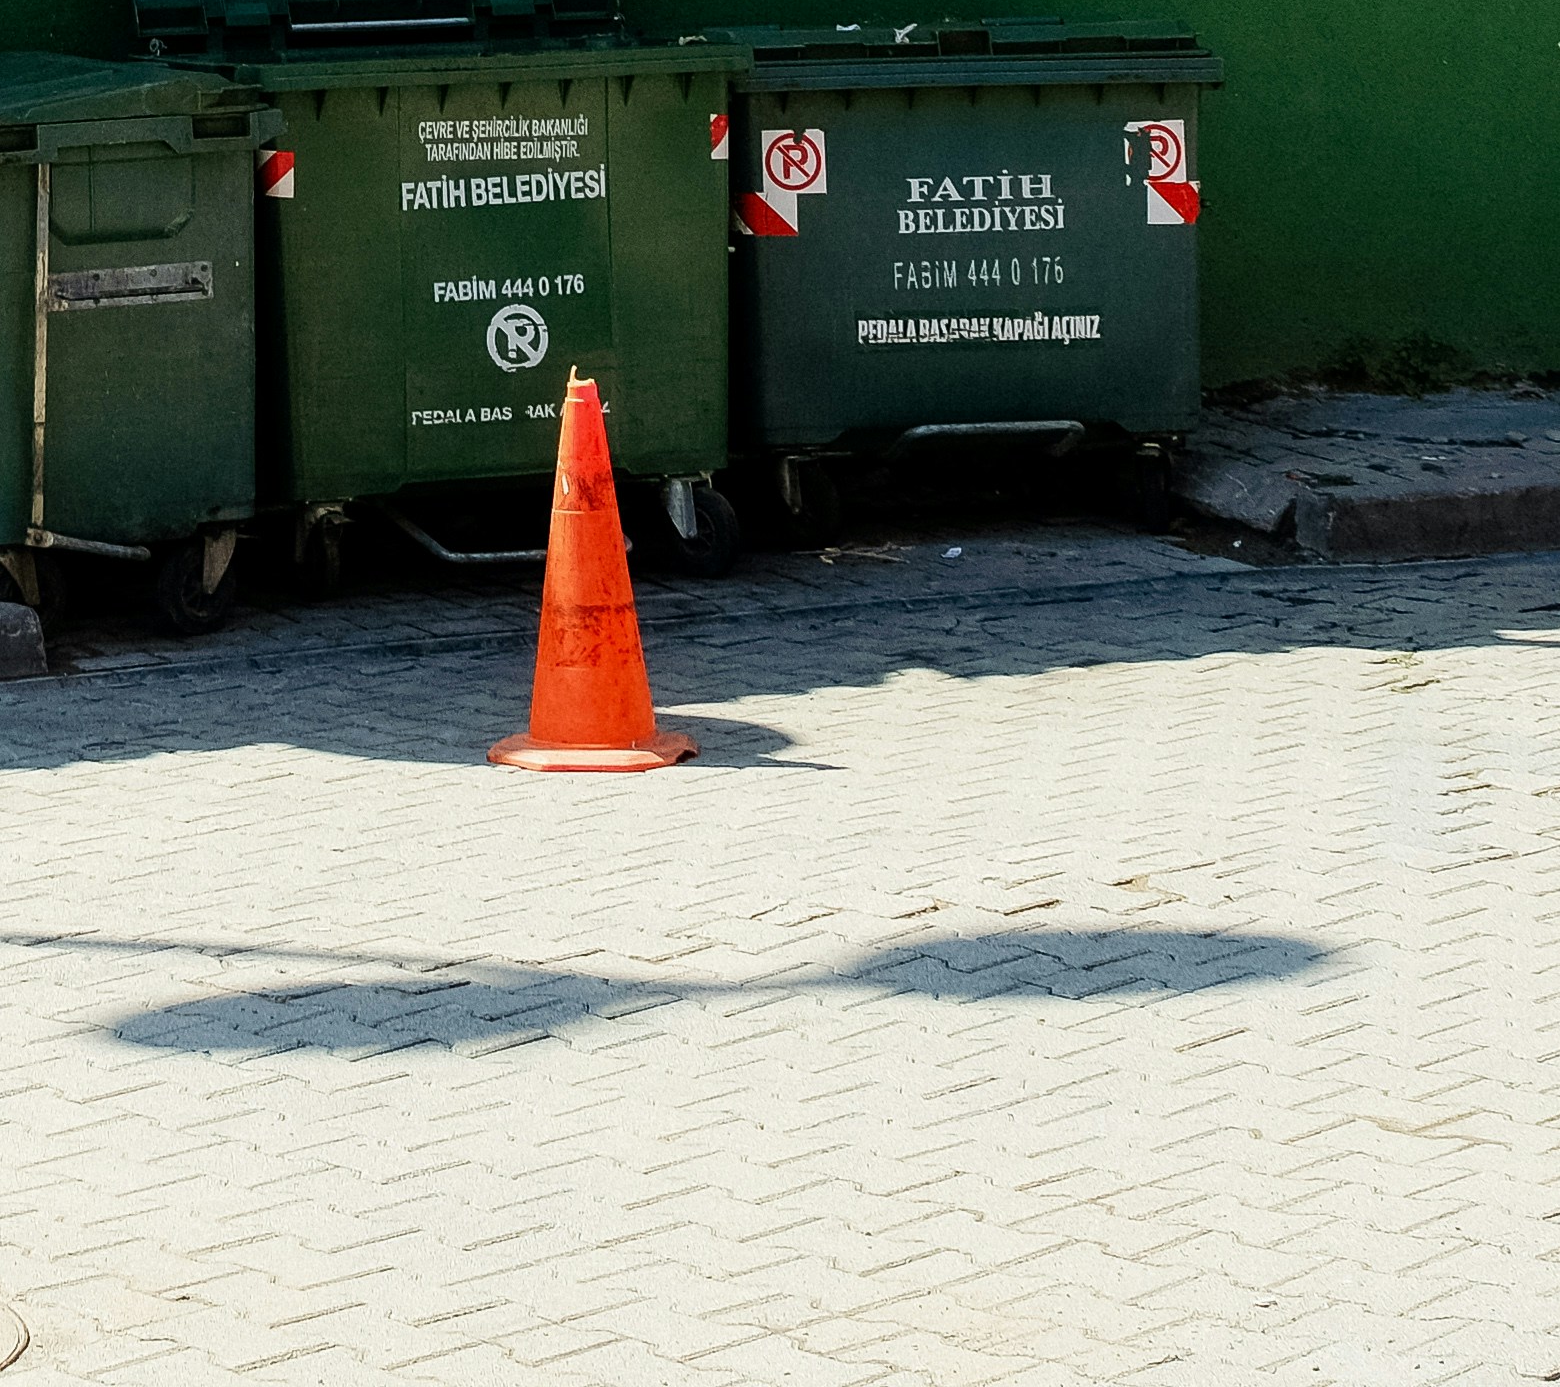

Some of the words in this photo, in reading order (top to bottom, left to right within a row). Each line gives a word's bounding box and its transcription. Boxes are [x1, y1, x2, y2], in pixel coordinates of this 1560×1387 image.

[418, 120, 454, 144] ÇEVRE
[456, 120, 470, 139] VE
[472, 114, 530, 142] ŞEHİRCİLİK
[532, 113, 588, 136] BAKANLIĞI
[425, 141, 491, 162] TARAFINDAN
[493, 138, 518, 160] HİBE
[401, 174, 467, 211] FATİH
[471, 163, 606, 207] BELEDİYESİ
[905, 169, 1055, 203] FATİH
[897, 198, 1065, 234] BELEDİYESİ
[433, 275, 497, 303] FABİM
[501, 278, 534, 298] 444
[538, 276, 550, 297] 0
[554, 274, 585, 296] 176
[893, 260, 957, 291] FABİM
[967, 259, 1002, 287] 444
[1010, 257, 1021, 286] 0
[1031, 256, 1064, 285] 176
[858, 319, 917, 344] PEDALA
[992, 311, 1049, 341] KAPAĞI
[1051, 314, 1101, 345] AÇINIZ
